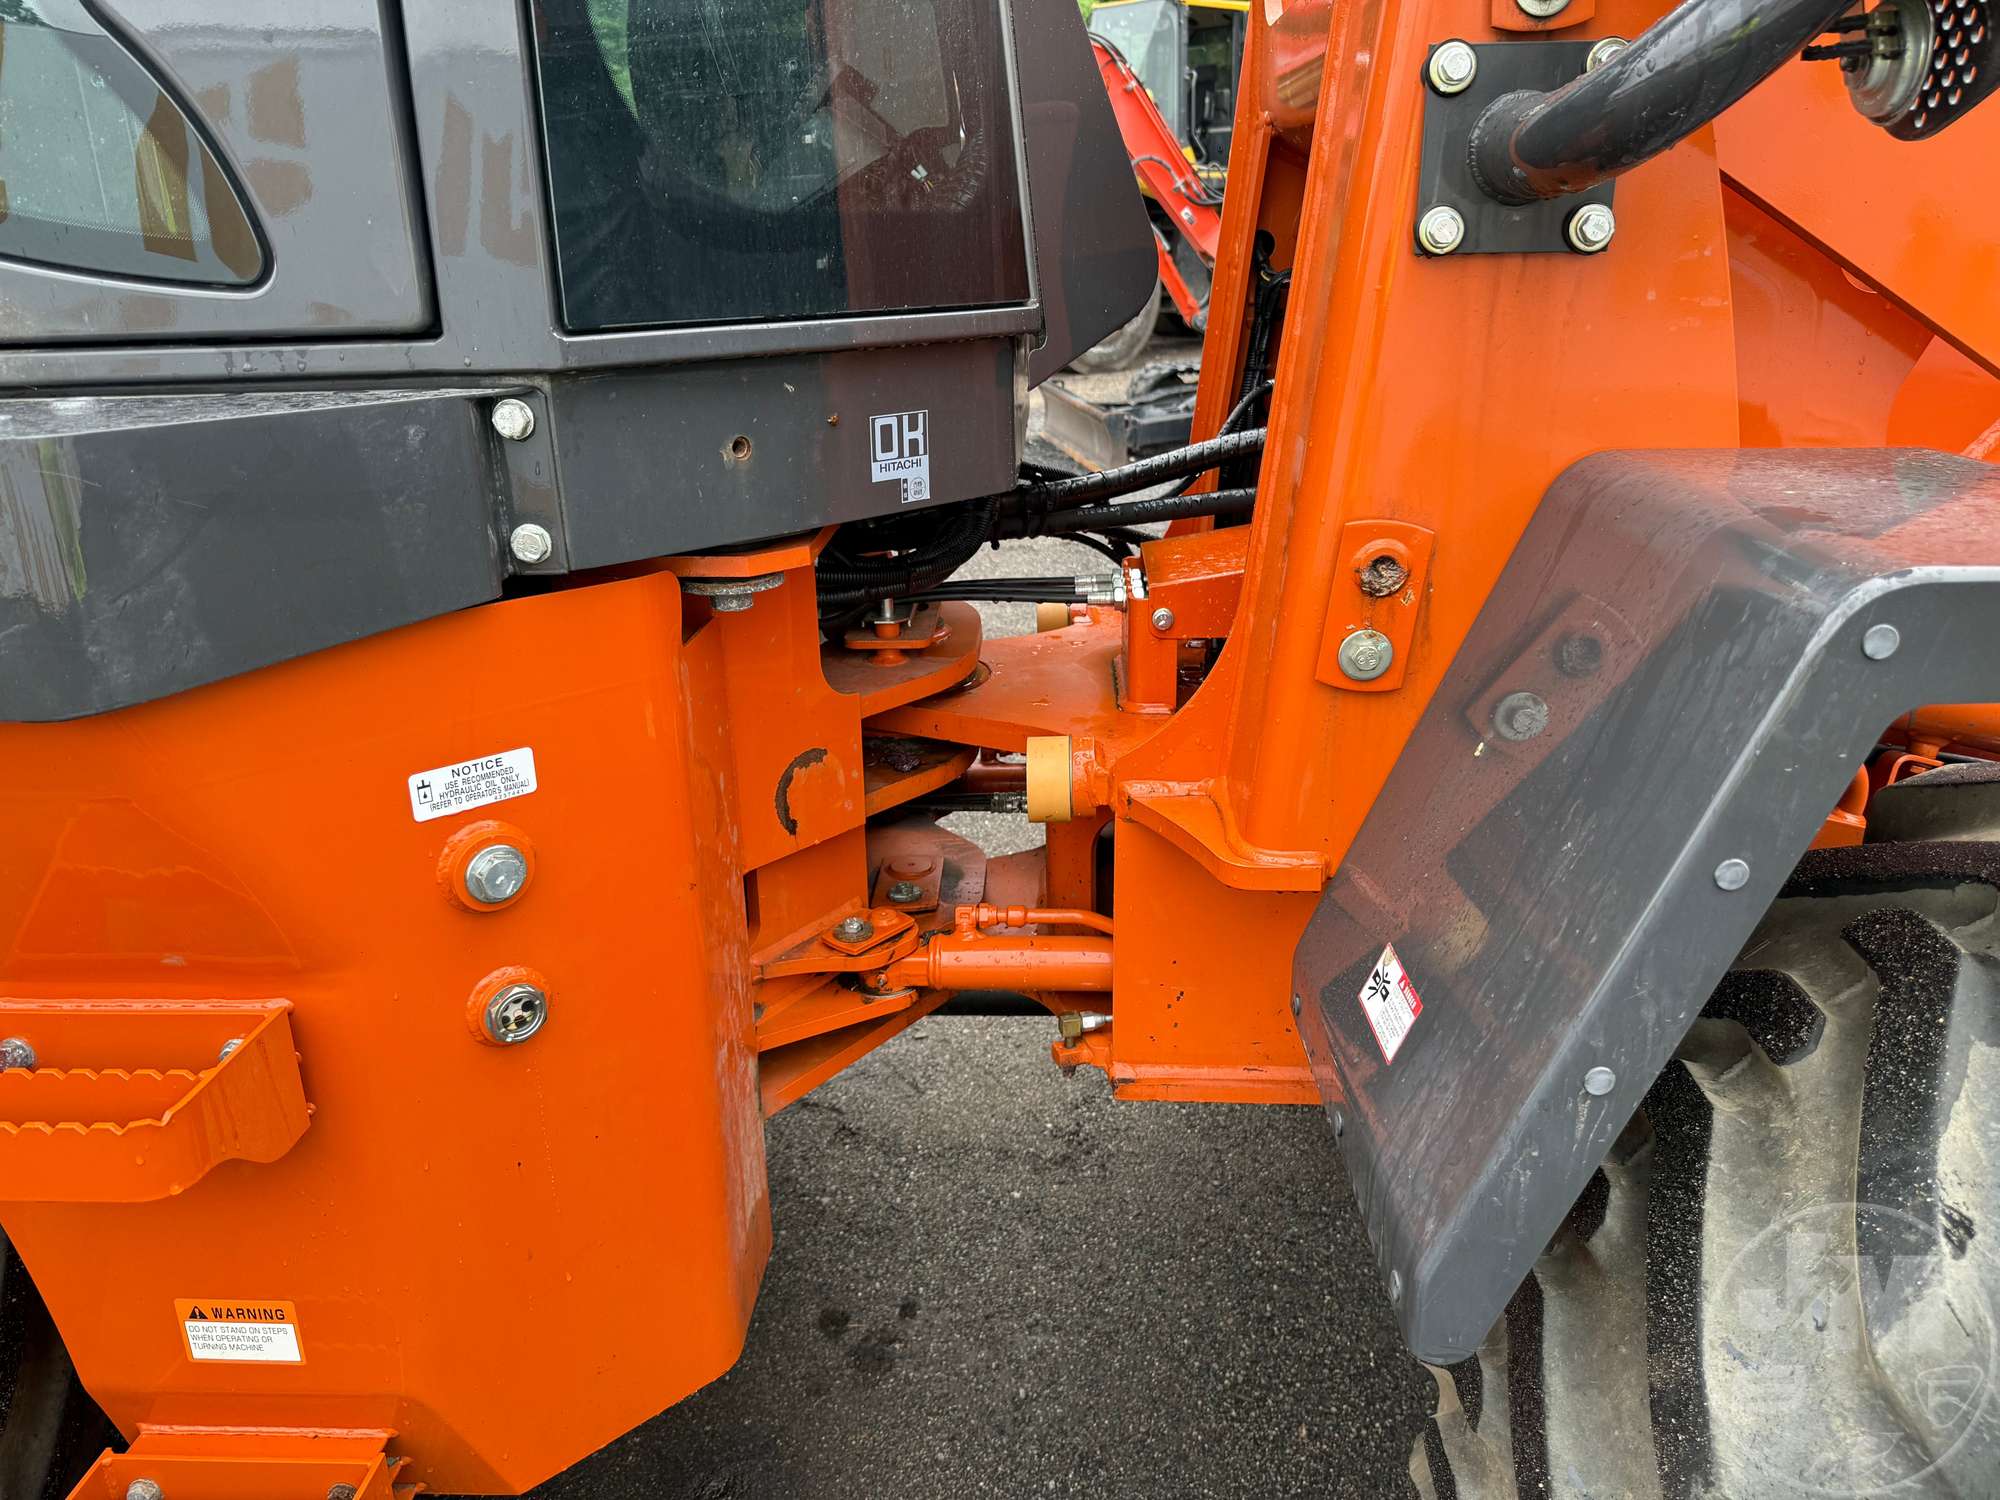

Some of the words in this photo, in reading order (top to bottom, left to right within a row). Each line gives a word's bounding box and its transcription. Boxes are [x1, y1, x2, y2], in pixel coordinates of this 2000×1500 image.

[880, 458, 922, 473] HITACHI
[451, 757, 504, 778] NOTICE
[445, 780, 459, 790] USE
[462, 766, 514, 785] RECOMMENDED
[439, 783, 481, 800] HYDRAULIC
[485, 779, 497, 788] OIL
[500, 773, 520, 784] ONLY
[429, 799, 452, 812] (REFER
[454, 796, 463, 804] TO
[503, 778, 530, 792] MANUAL)
[211, 1307, 285, 1320] WARNING
[188, 1325, 200, 1333] DO
[202, 1325, 219, 1333] NOT
[221, 1326, 247, 1334] STAND
[249, 1326, 261, 1334] ON
[262, 1327, 288, 1335] STEPS
[190, 1334, 214, 1342] WHEN
[215, 1335, 259, 1343] OPERATING
[261, 1335, 273, 1343] OR
[192, 1342, 227, 1351] TURNING
[228, 1343, 265, 1352] MACHINE
